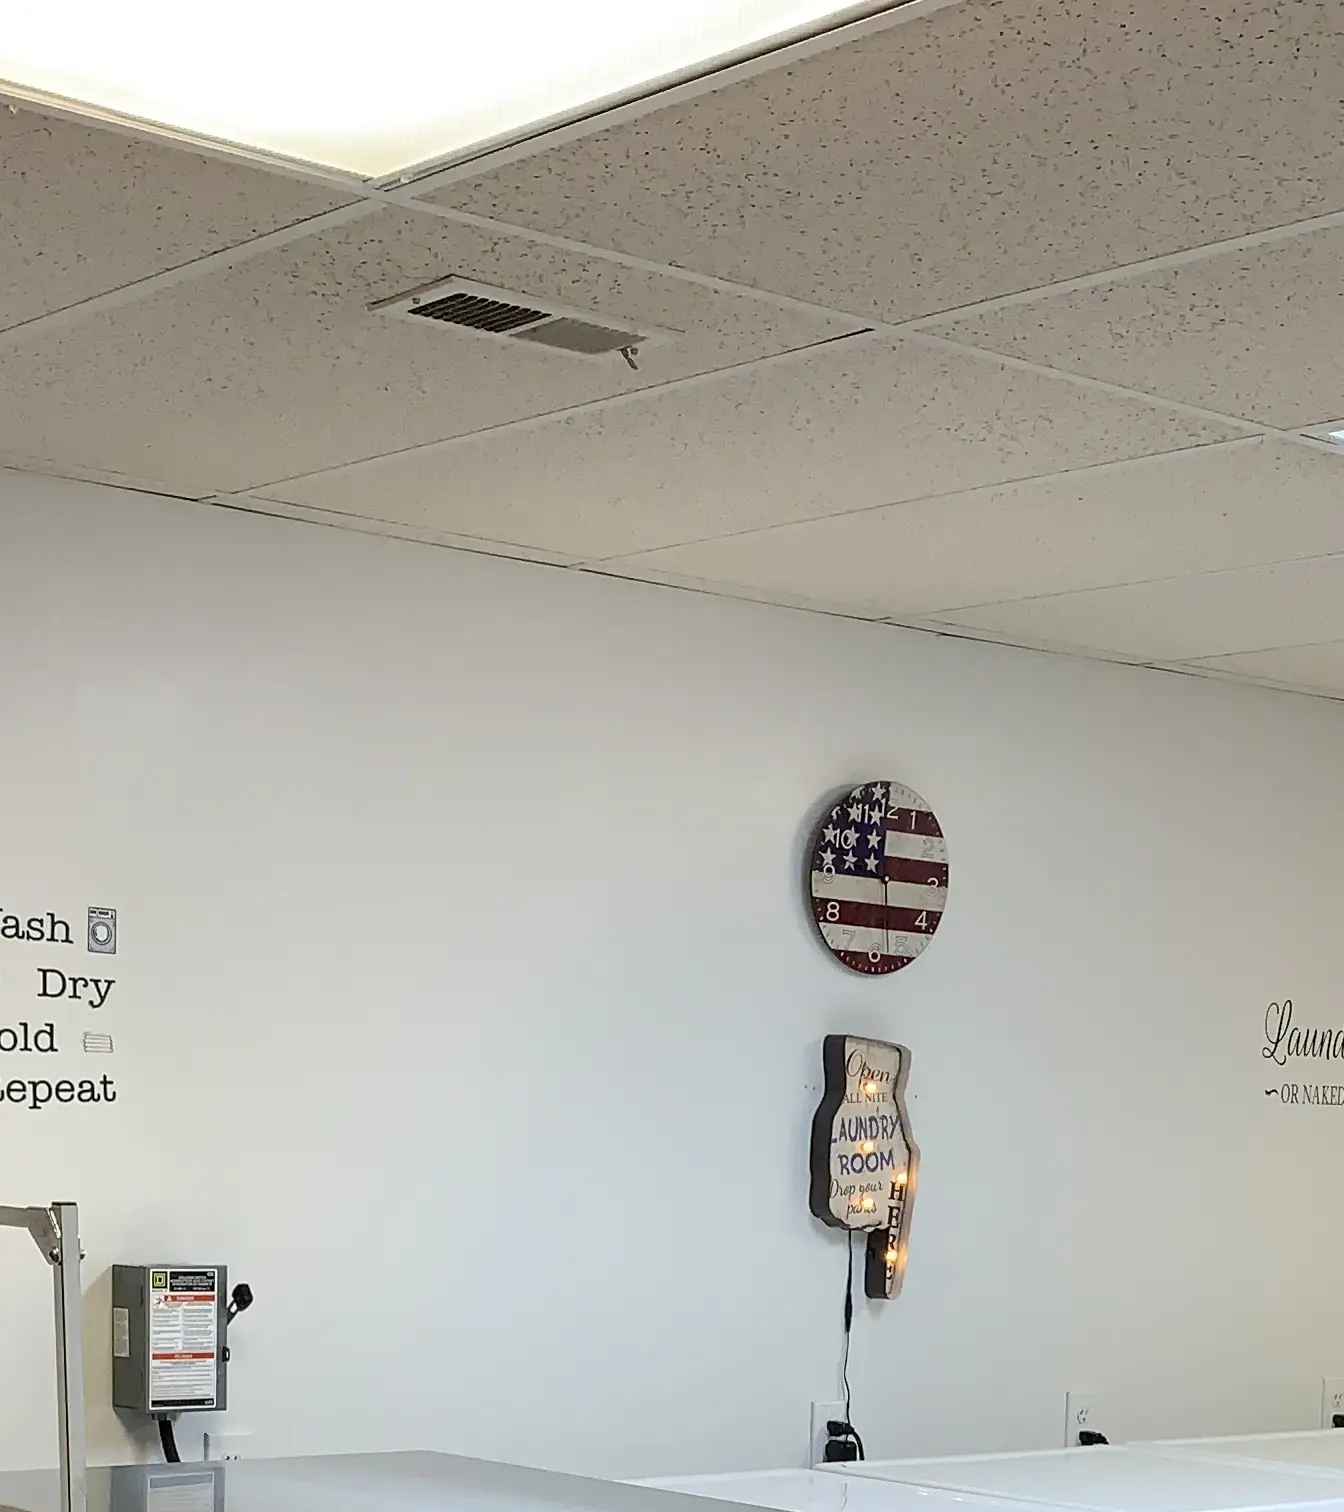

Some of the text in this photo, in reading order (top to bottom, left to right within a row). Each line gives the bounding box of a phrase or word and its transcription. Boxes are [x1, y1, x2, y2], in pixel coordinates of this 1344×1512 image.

[826, 901, 840, 921] 8
[914, 911, 928, 930] 4
[37, 968, 116, 1008] Dry
[846, 1049, 891, 1090] Open
[843, 1091, 889, 1104] ALL NITE
[1281, 1083, 1299, 1104] OR
[837, 1149, 895, 1175] ROOM
[830, 1179, 883, 1200] Drop your
[846, 1202, 877, 1220] pas
